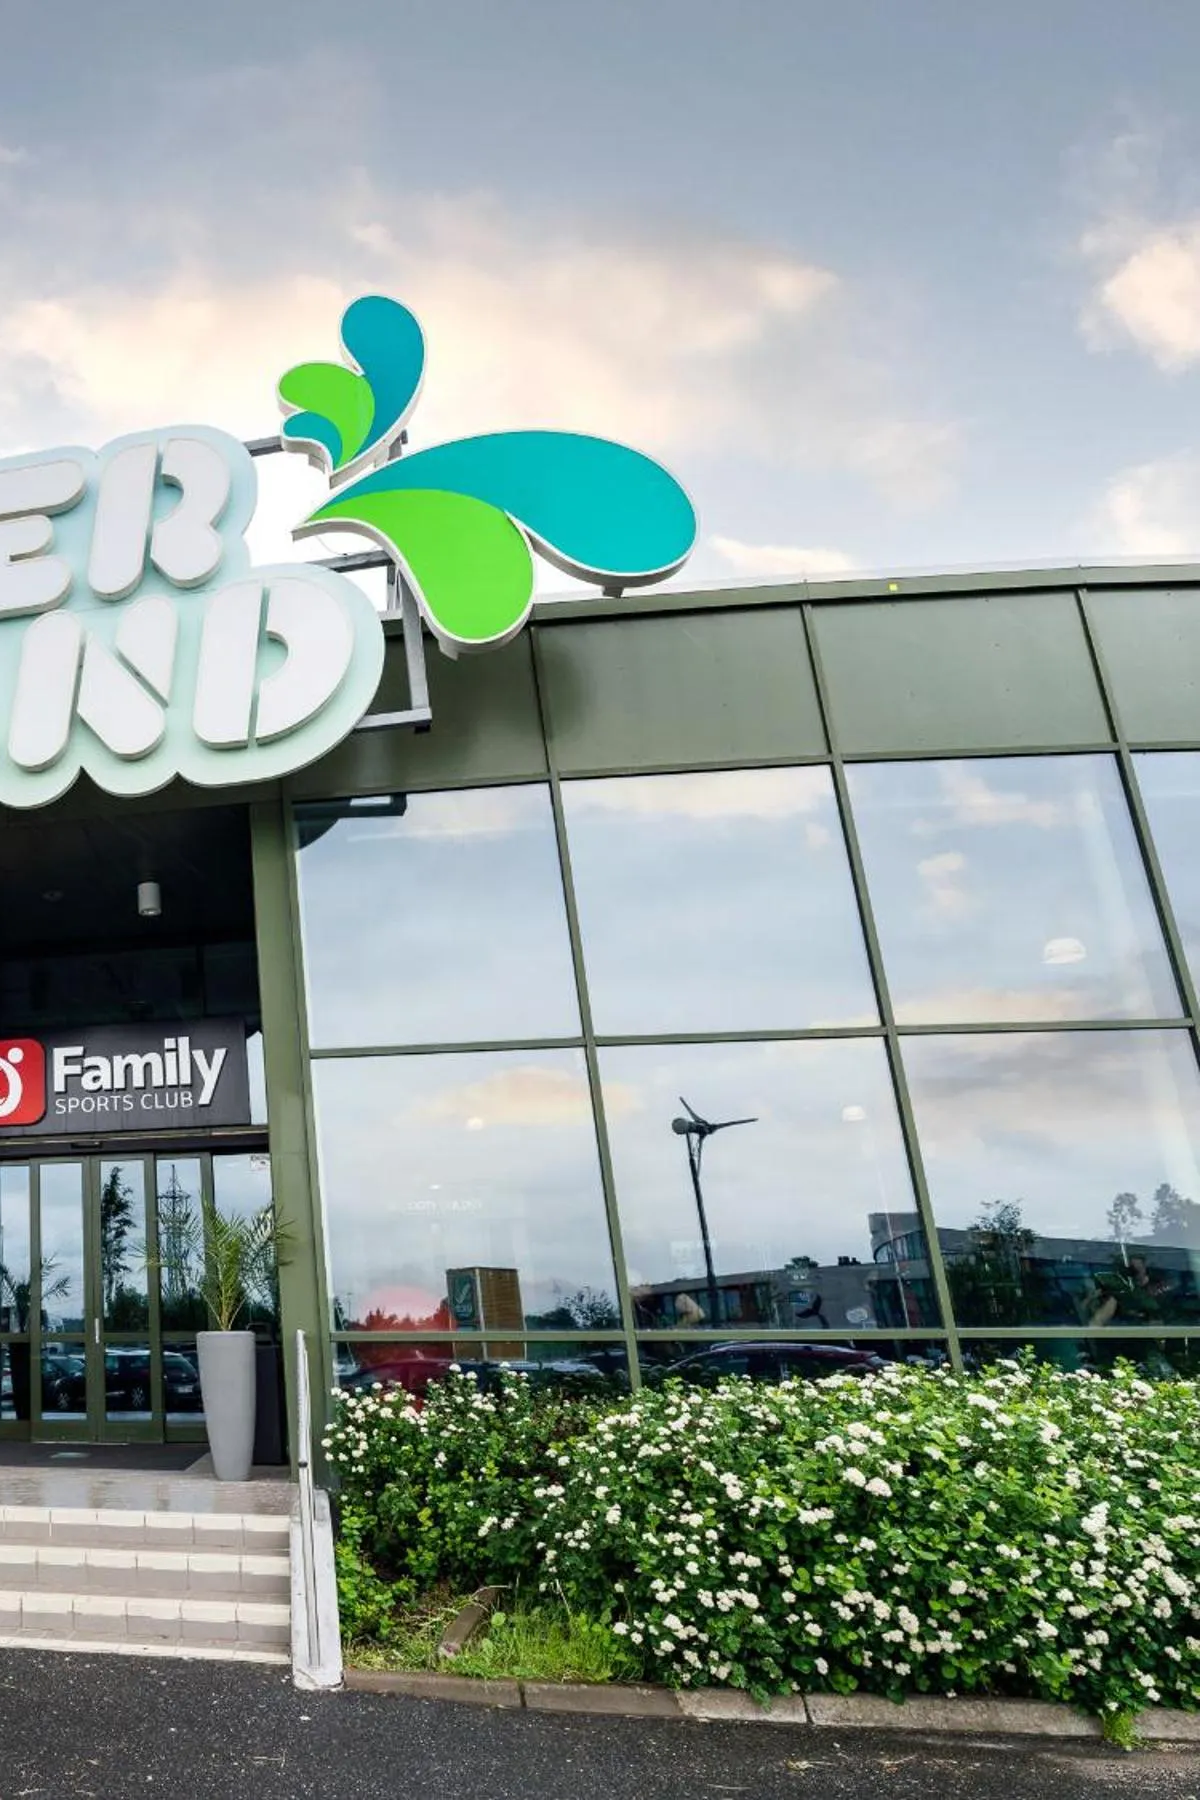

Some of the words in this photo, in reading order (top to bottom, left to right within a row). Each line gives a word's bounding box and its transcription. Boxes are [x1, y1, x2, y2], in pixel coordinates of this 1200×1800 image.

[53, 1036, 228, 1106] Family
[55, 1094, 134, 1115] SPORTS
[140, 1090, 194, 1110] CLUB
